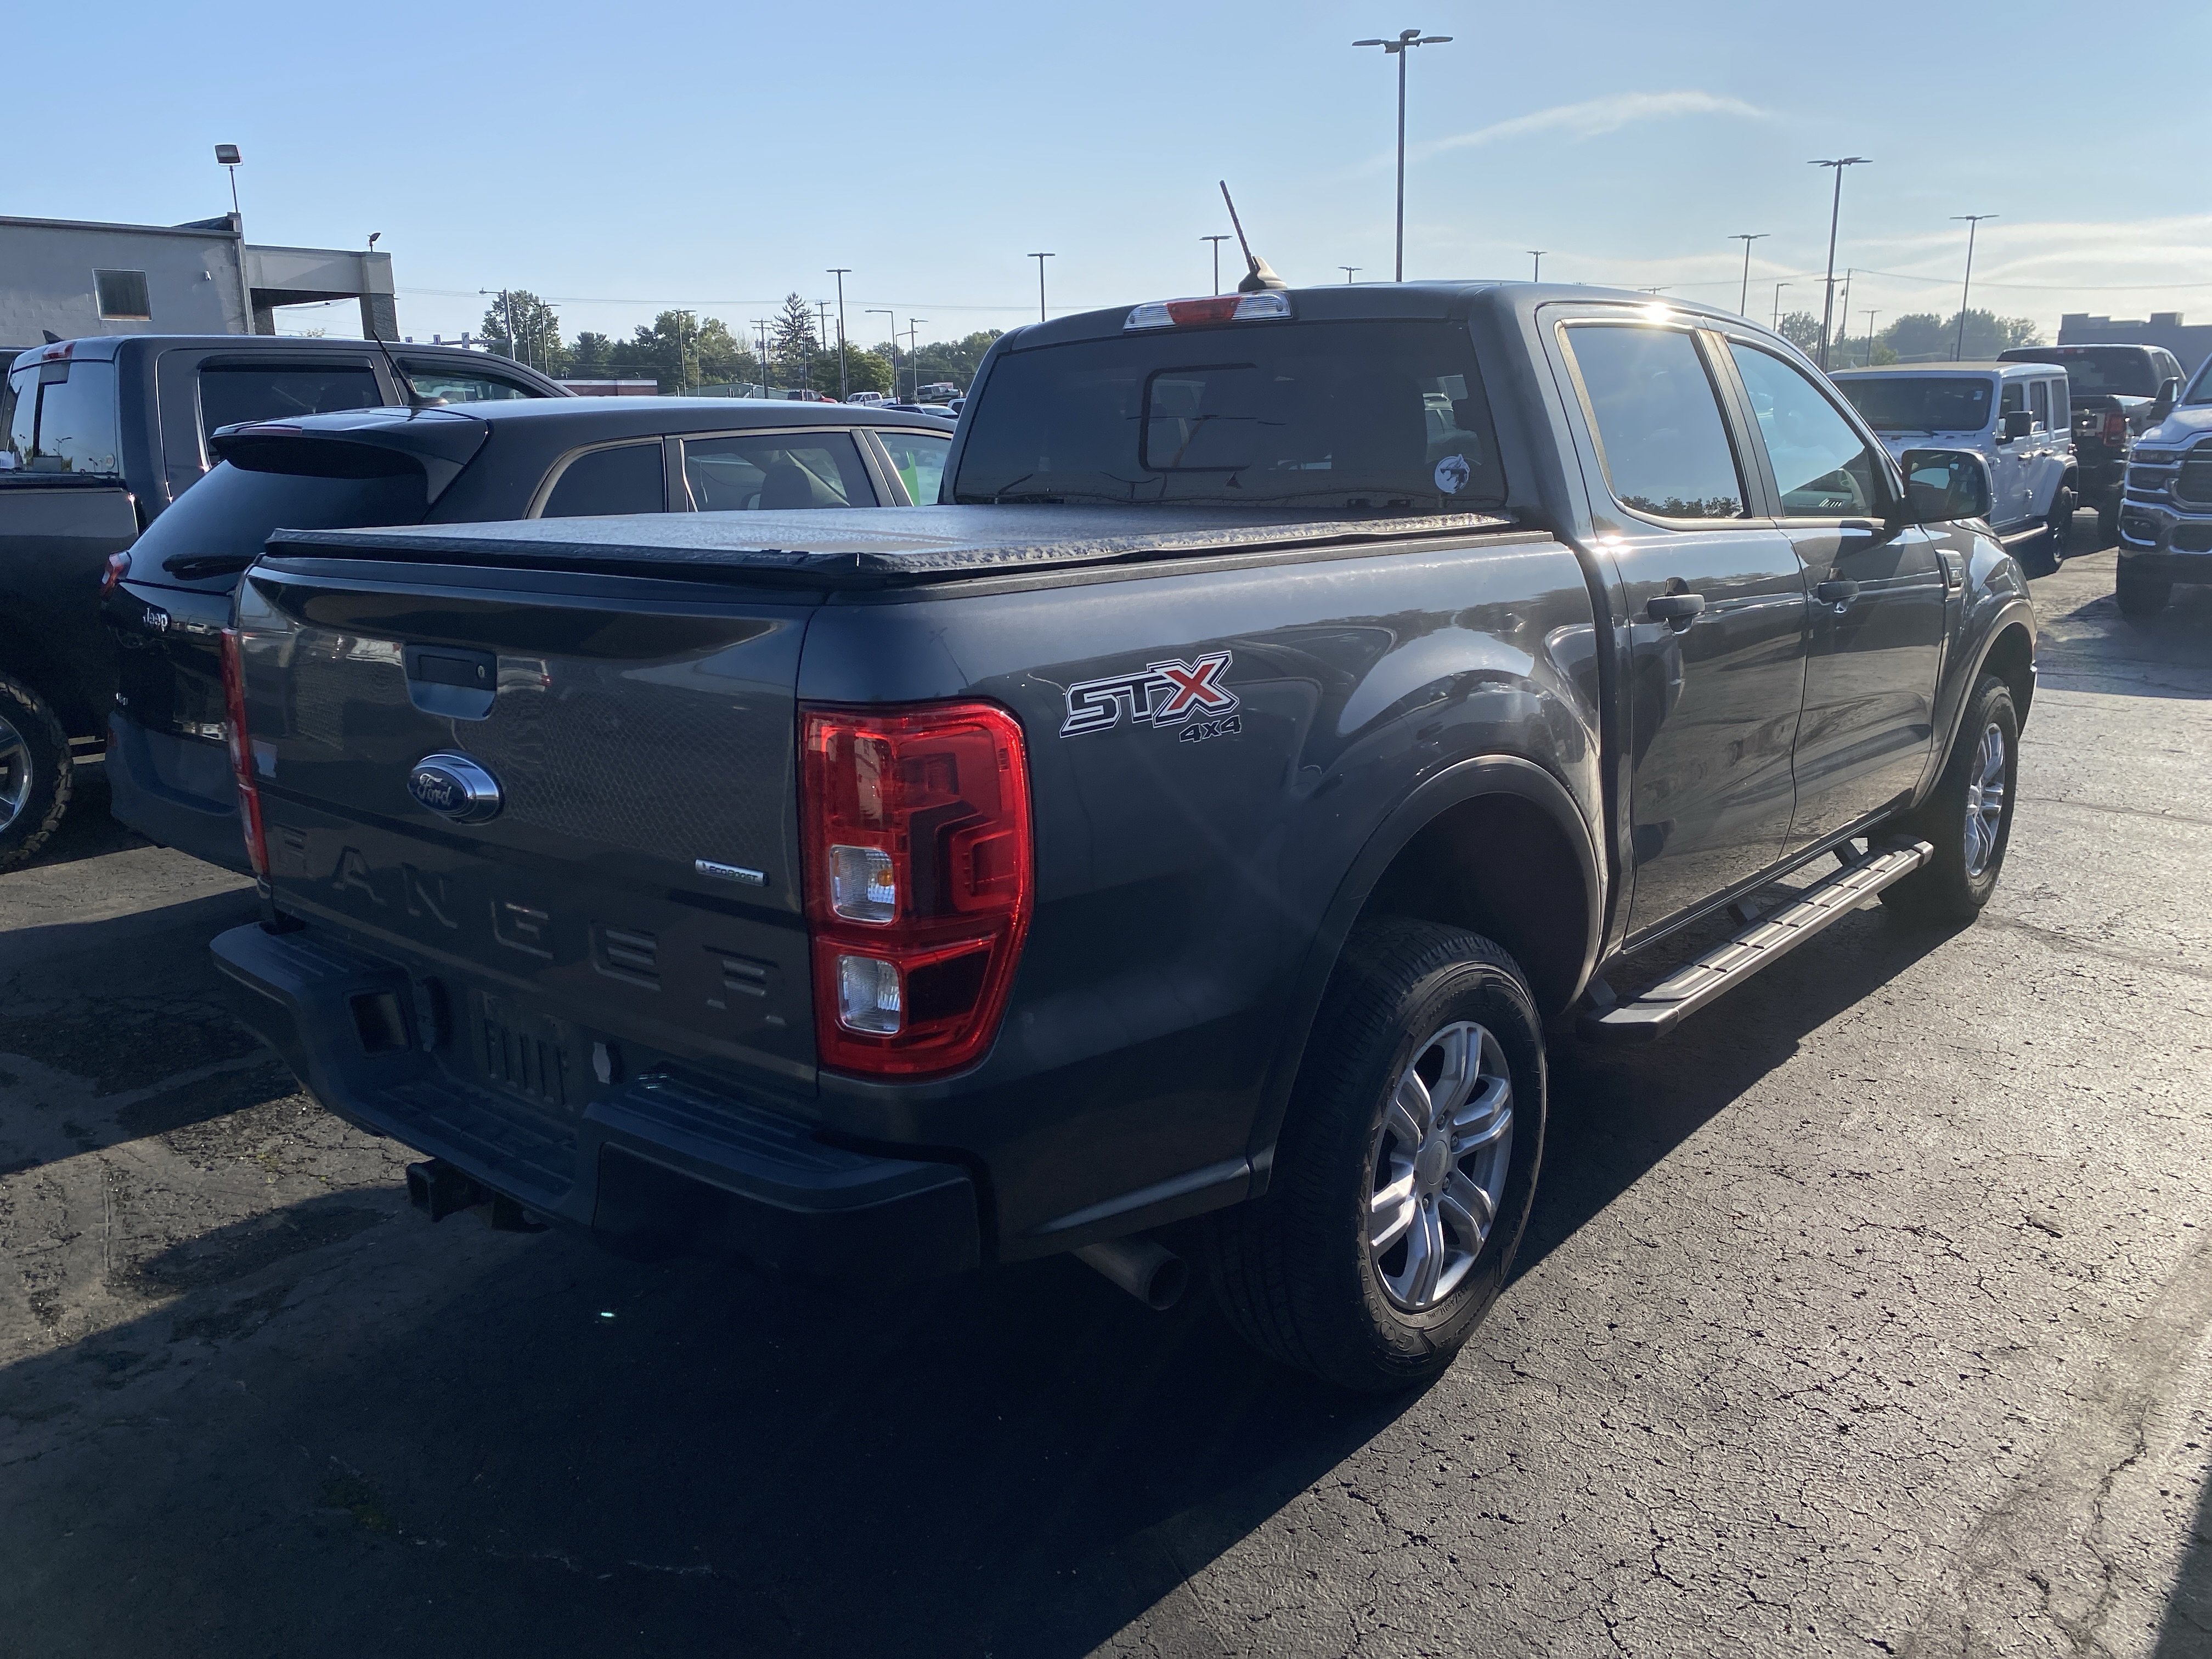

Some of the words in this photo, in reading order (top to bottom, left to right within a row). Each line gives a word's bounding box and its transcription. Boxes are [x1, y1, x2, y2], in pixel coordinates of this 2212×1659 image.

[1059, 650, 1239, 739] STX
[417, 773, 453, 807] Ford
[272, 823, 787, 1026] RANGER
